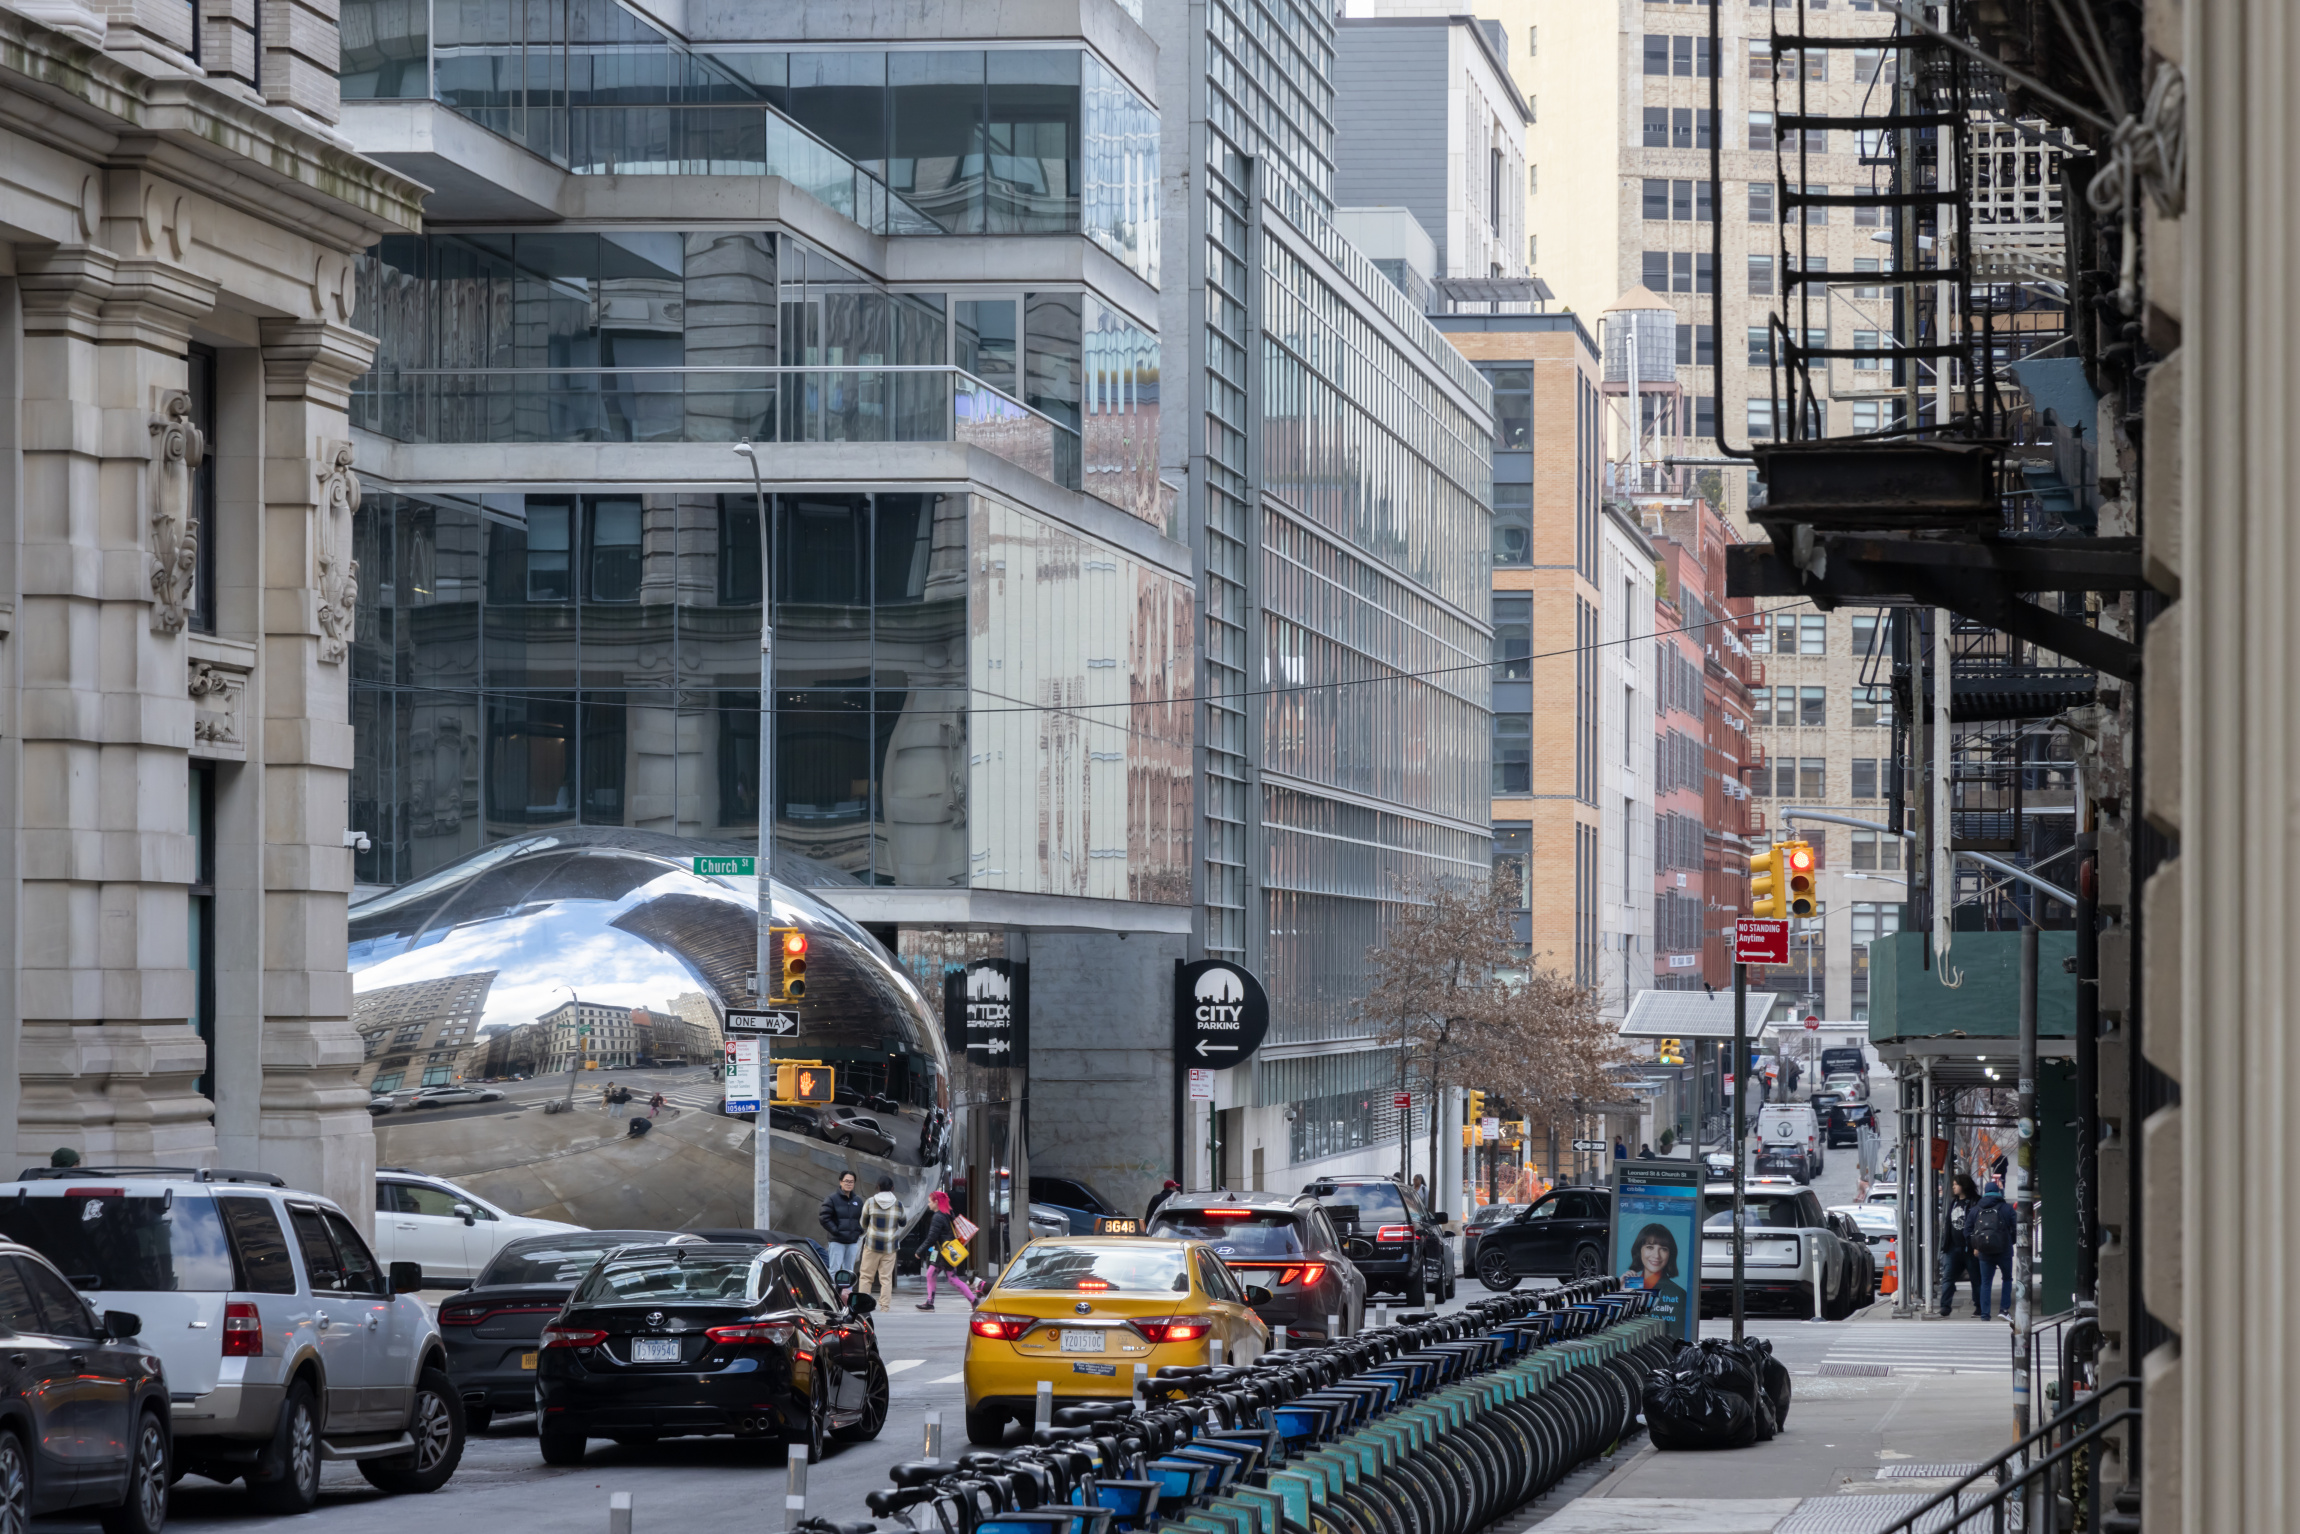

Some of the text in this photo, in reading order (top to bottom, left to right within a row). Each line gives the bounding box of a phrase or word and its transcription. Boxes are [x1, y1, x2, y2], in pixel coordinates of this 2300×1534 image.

[700, 858, 749, 873] Church St
[1739, 923, 1781, 933] NO STANDING
[1739, 933, 1765, 944] Anytime
[1195, 1005, 1244, 1022] CITY
[735, 1016, 788, 1029] ONE WAY
[1197, 1021, 1240, 1030] PARKING
[728, 1065, 735, 1076] 2
[1662, 1295, 1679, 1303] that
[1064, 1335, 1102, 1348] Y201510C
